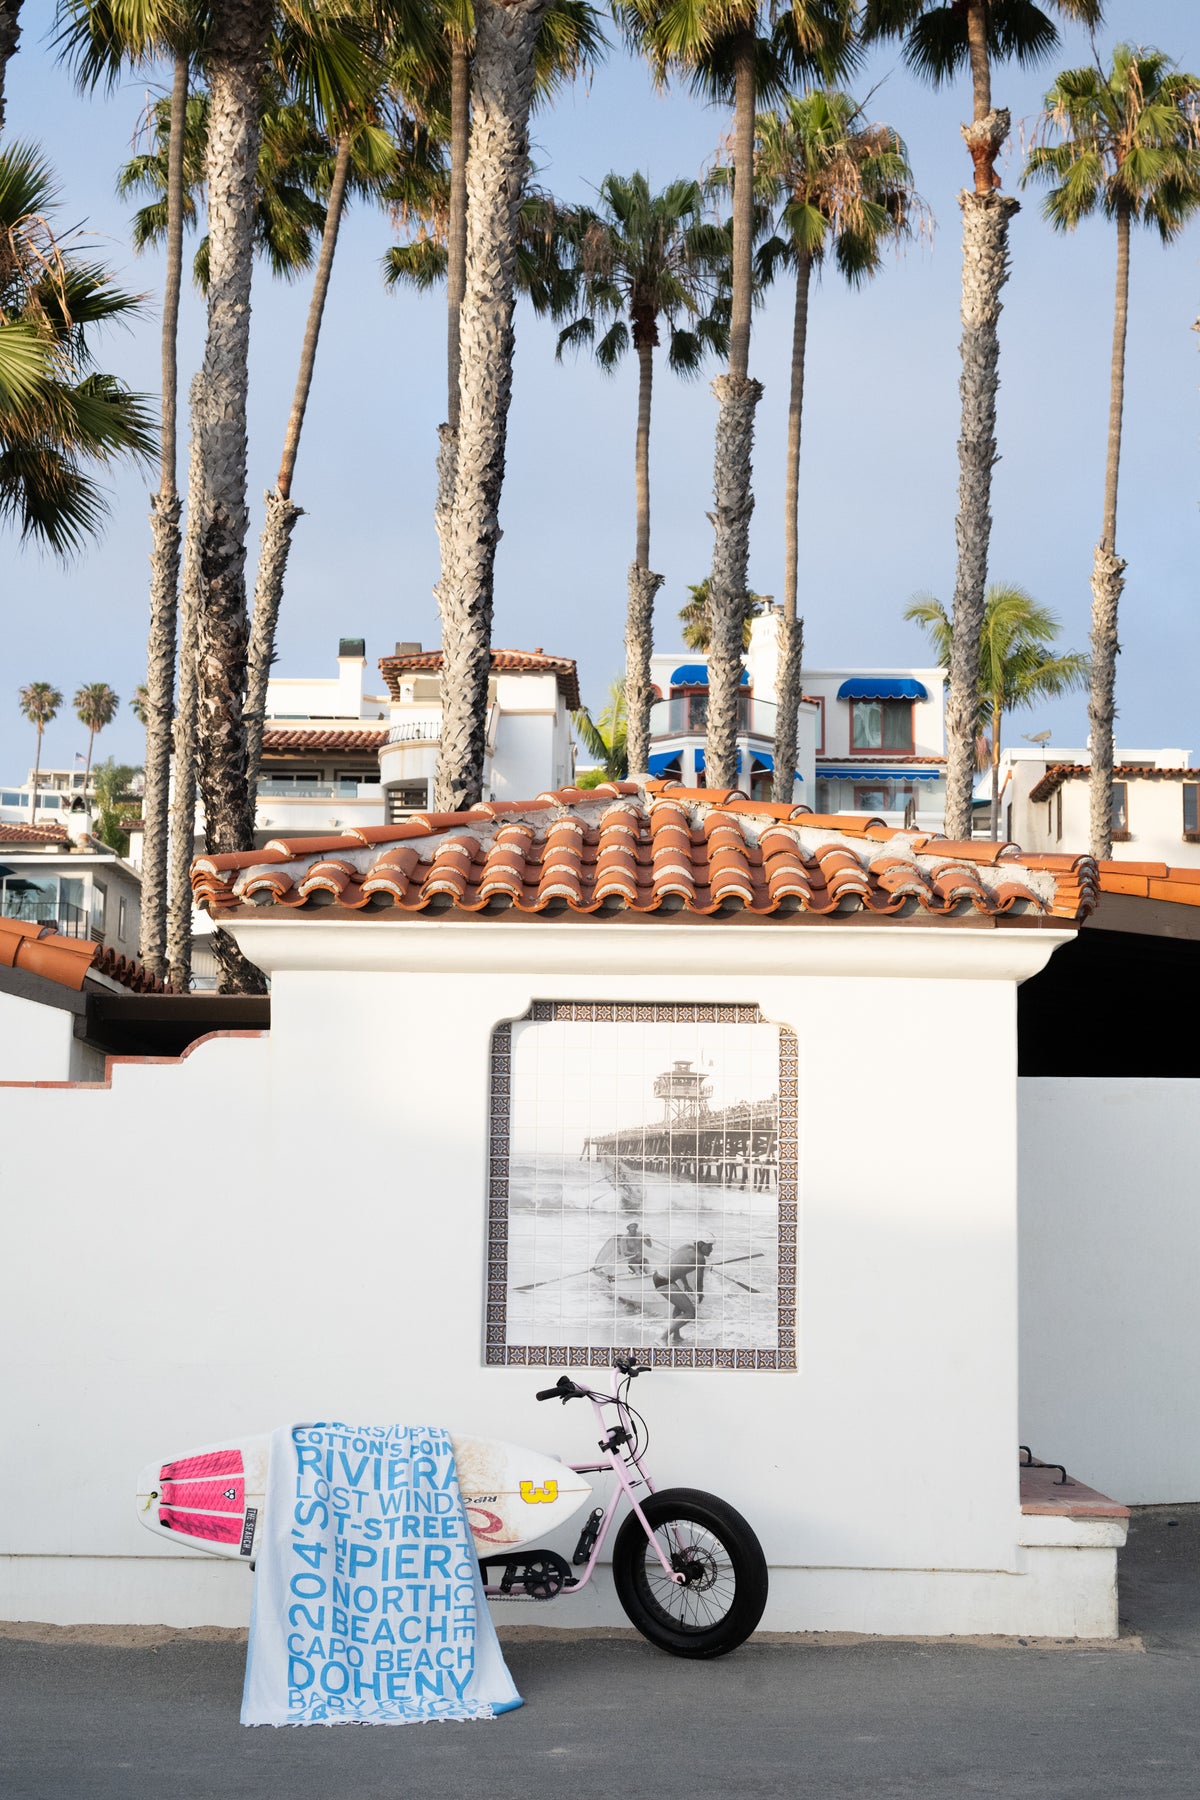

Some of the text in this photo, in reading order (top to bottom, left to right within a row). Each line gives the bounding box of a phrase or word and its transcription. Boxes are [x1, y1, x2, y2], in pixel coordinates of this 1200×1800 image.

[291, 1429, 455, 1459] COTTON'S POIN
[295, 1444, 459, 1491] RIVIERA
[296, 1475, 370, 1514] LOST
[242, 1509, 257, 1549] THE SEARCH
[348, 1543, 453, 1582] PIER
[332, 1575, 452, 1614] NORTH
[453, 1543, 476, 1642] POCHE
[331, 1605, 448, 1646] BEACH
[287, 1632, 476, 1672] CAPO BEACH
[287, 1654, 475, 1701] DOHENY
